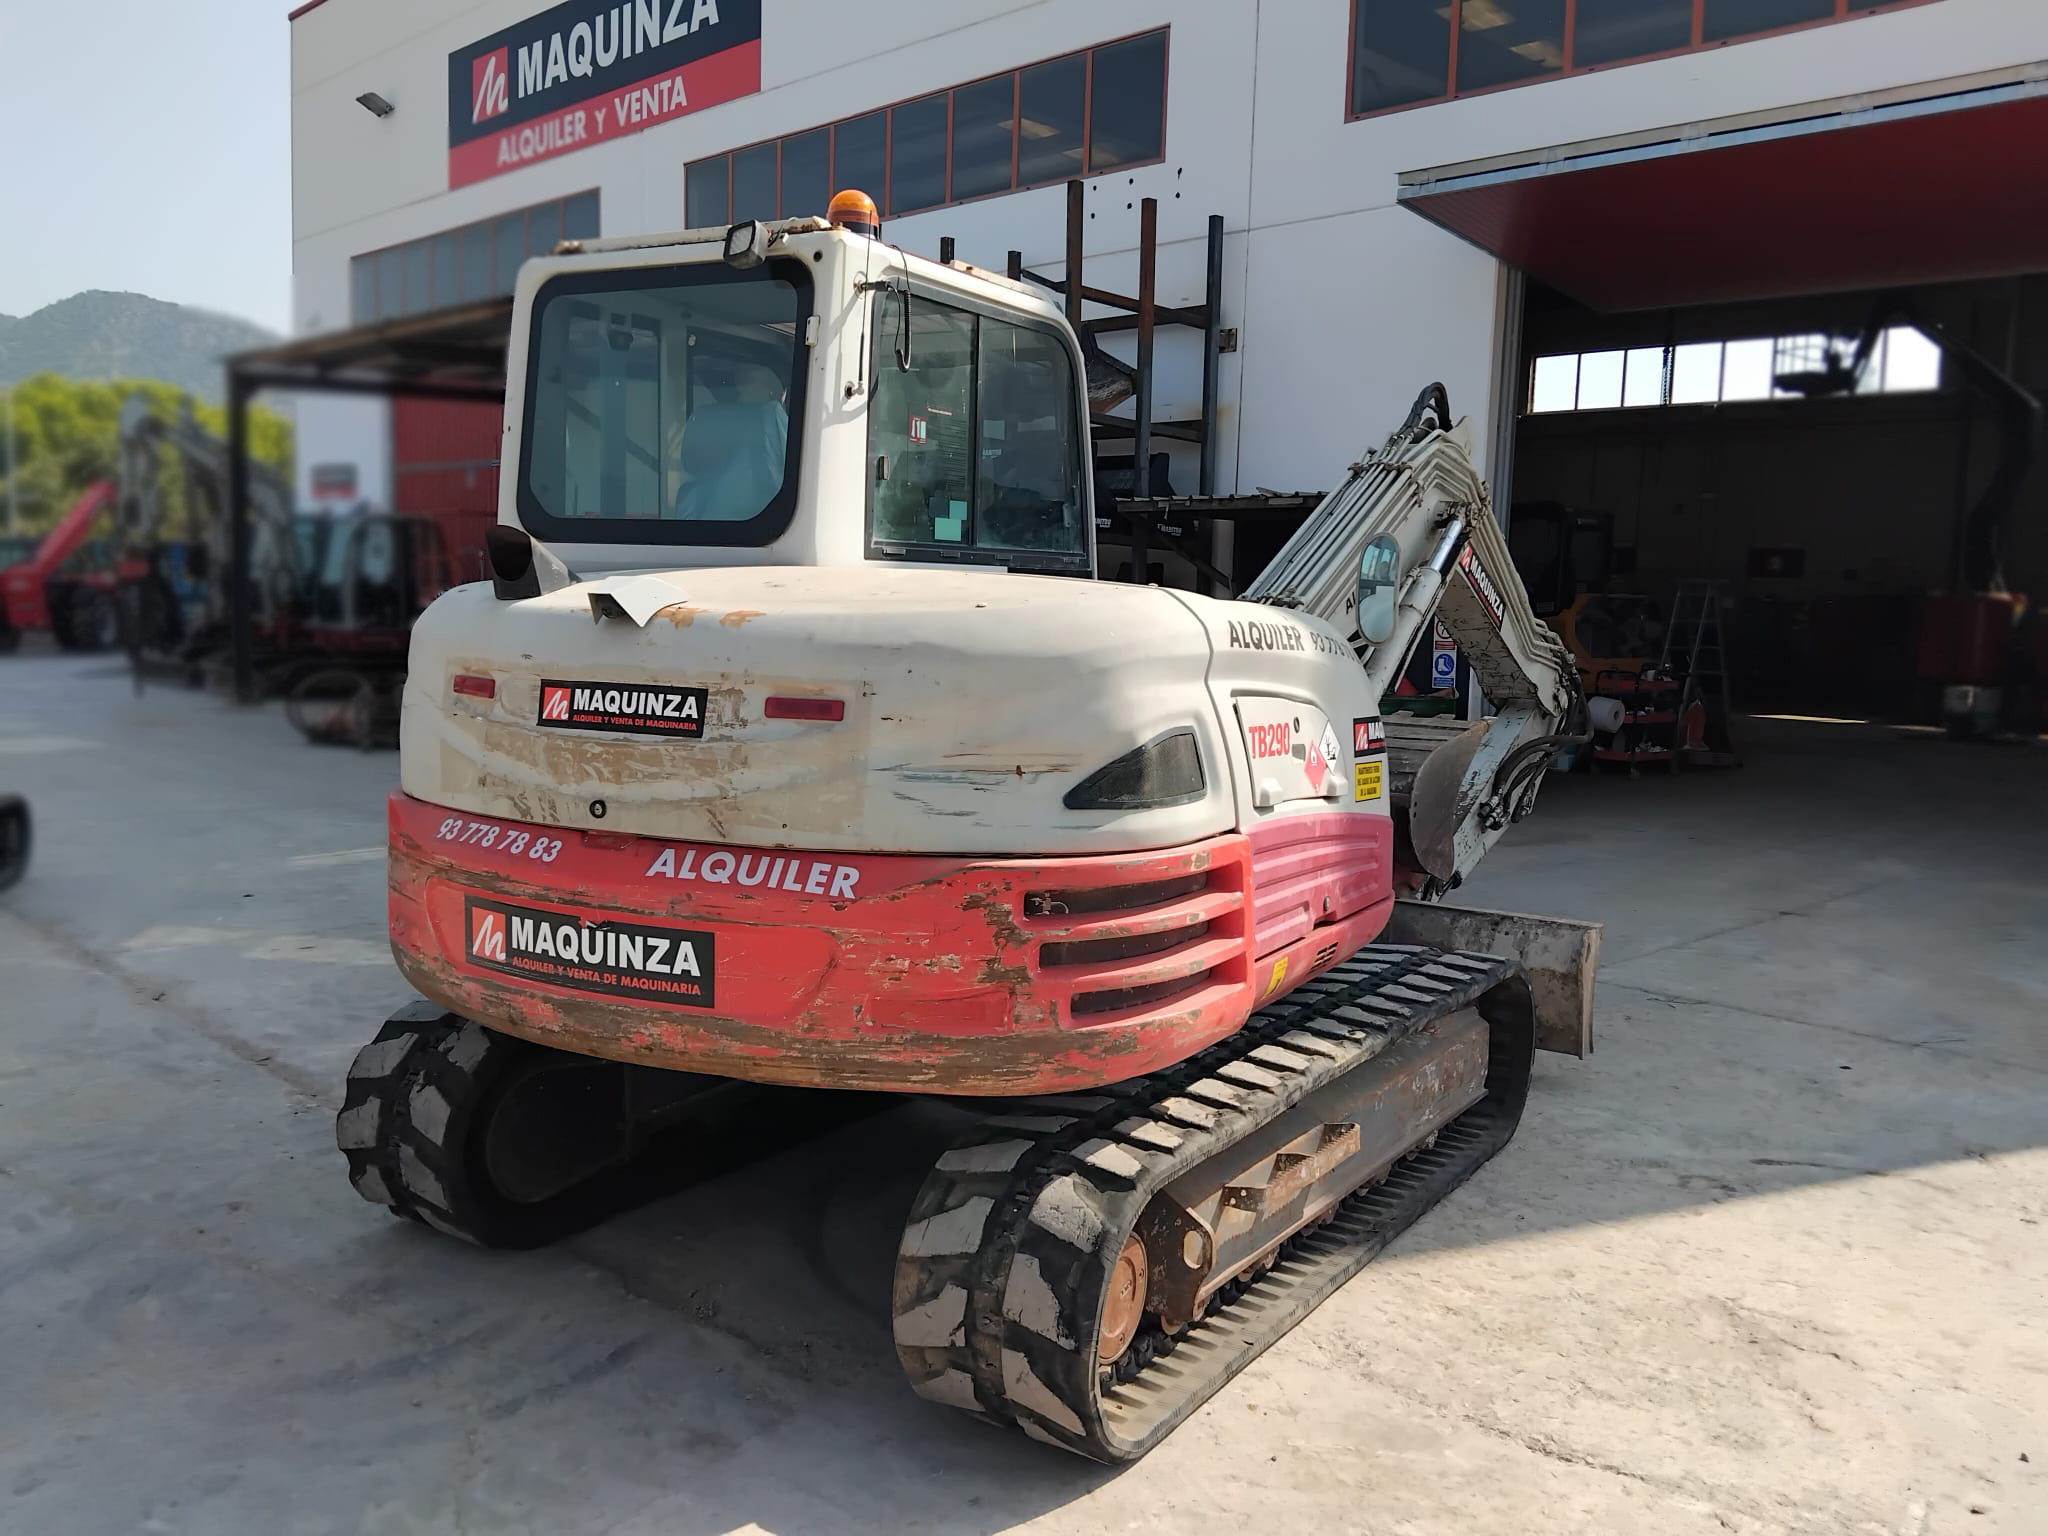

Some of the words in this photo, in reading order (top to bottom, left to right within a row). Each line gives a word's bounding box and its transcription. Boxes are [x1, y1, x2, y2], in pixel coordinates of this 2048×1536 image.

[497, 110, 587, 167] ALQUILER
[594, 107, 607, 135] Y
[614, 75, 688, 127] VENTA
[1470, 554, 1504, 621] MAQUINZA
[1228, 620, 1305, 651] ALQUILER
[572, 714, 603, 724] ALQUILER
[603, 716, 609, 724] Y
[611, 717, 633, 726] VENTA
[634, 719, 644, 727] DE
[646, 719, 697, 731] MAQUINARIA
[573, 688, 699, 719] MAQUINZA
[1248, 722, 1291, 759] TB290
[436, 818, 463, 840] 93
[459, 821, 500, 848] 778
[496, 829, 530, 854] 78
[528, 836, 562, 862] 83
[645, 847, 860, 899] ALQUILER
[511, 915, 701, 977] MAQUINZA
[512, 956, 555, 974] ALQUILER
[556, 964, 564, 976] Y
[567, 967, 601, 983] VENTA
[603, 973, 617, 985] DE
[620, 976, 701, 996] MAQUINARIA
